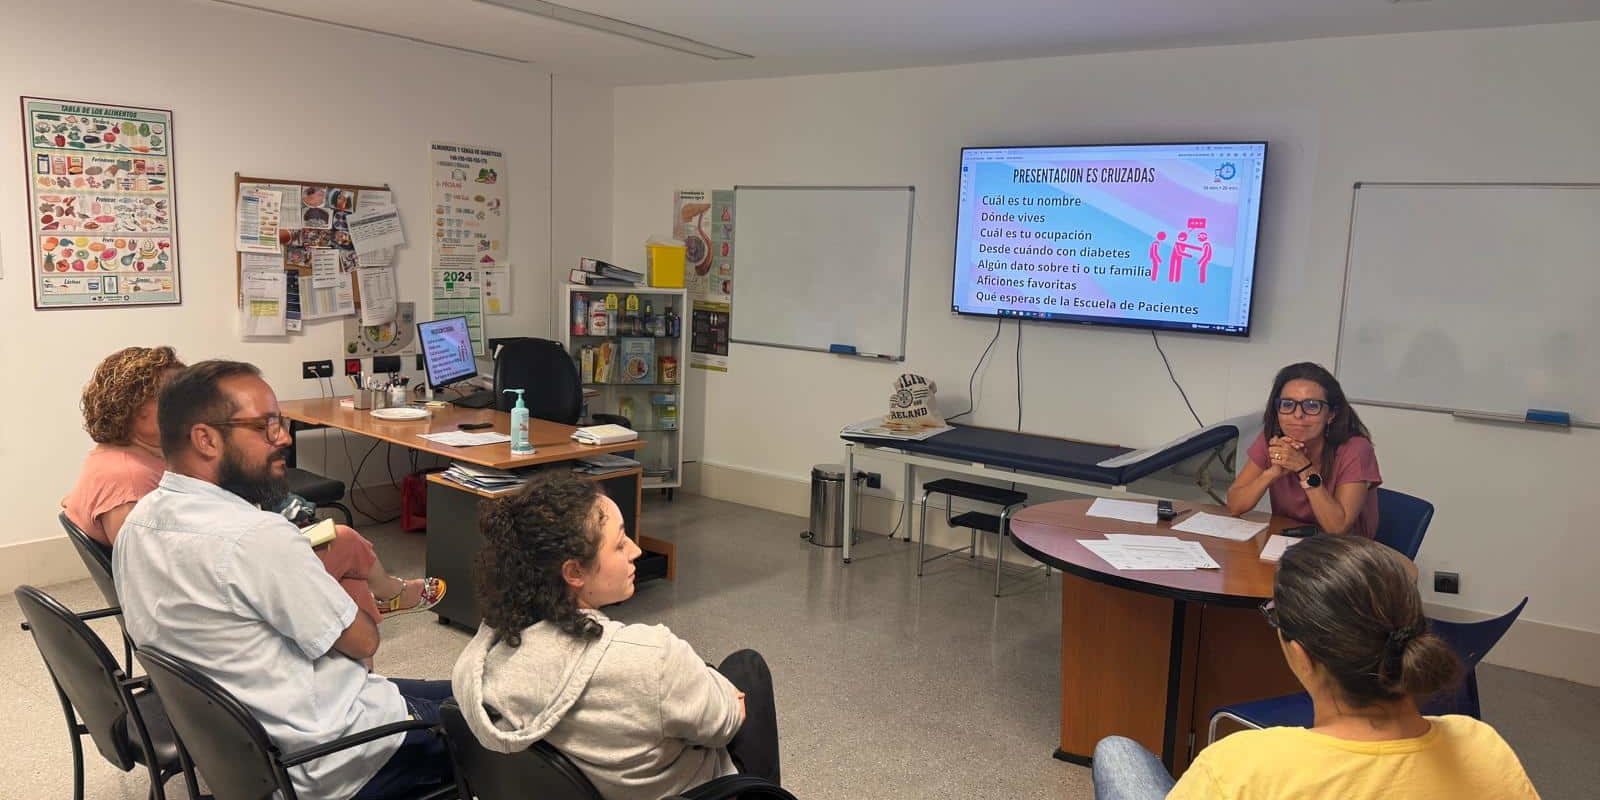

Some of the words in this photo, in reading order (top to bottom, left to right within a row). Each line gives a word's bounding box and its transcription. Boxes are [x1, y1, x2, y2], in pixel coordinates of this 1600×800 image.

[1013, 167, 1083, 183] PRESENTACION
[1086, 167, 1098, 183] ES
[1101, 167, 1155, 183] CRUZADAS
[982, 195, 1005, 206] Cuál
[1008, 197, 1020, 206] es
[1022, 196, 1034, 206] tu
[1037, 195, 1081, 207] nombre
[981, 212, 1015, 222] Dónde
[1018, 212, 1046, 223] vives
[980, 228, 1003, 238] Cuál
[1005, 230, 1017, 239] es
[1020, 230, 1031, 239] tu
[1034, 230, 1092, 242] ocupación
[979, 244, 1011, 254] Desde
[1013, 244, 1053, 256] cuándo
[1056, 248, 1076, 257] con
[1079, 247, 1131, 258] diabetes
[977, 259, 1007, 271] Algún
[1010, 260, 1035, 272] dato
[1037, 262, 1069, 273] sobre
[1072, 263, 1080, 273] ti
[1083, 266, 1090, 274] o
[1094, 265, 1106, 275] tu
[1110, 265, 1152, 277] familia
[443, 271, 472, 282] 2024
[976, 275, 1025, 288] Aficiones
[1028, 277, 1077, 290] favoritas
[976, 291, 997, 303] Qué
[1000, 294, 1041, 305] esperas
[1043, 295, 1057, 306] de
[1060, 296, 1070, 306] la
[1073, 297, 1116, 309] Escuela
[1120, 299, 1135, 311] de
[1138, 301, 1199, 315] Pacientes
